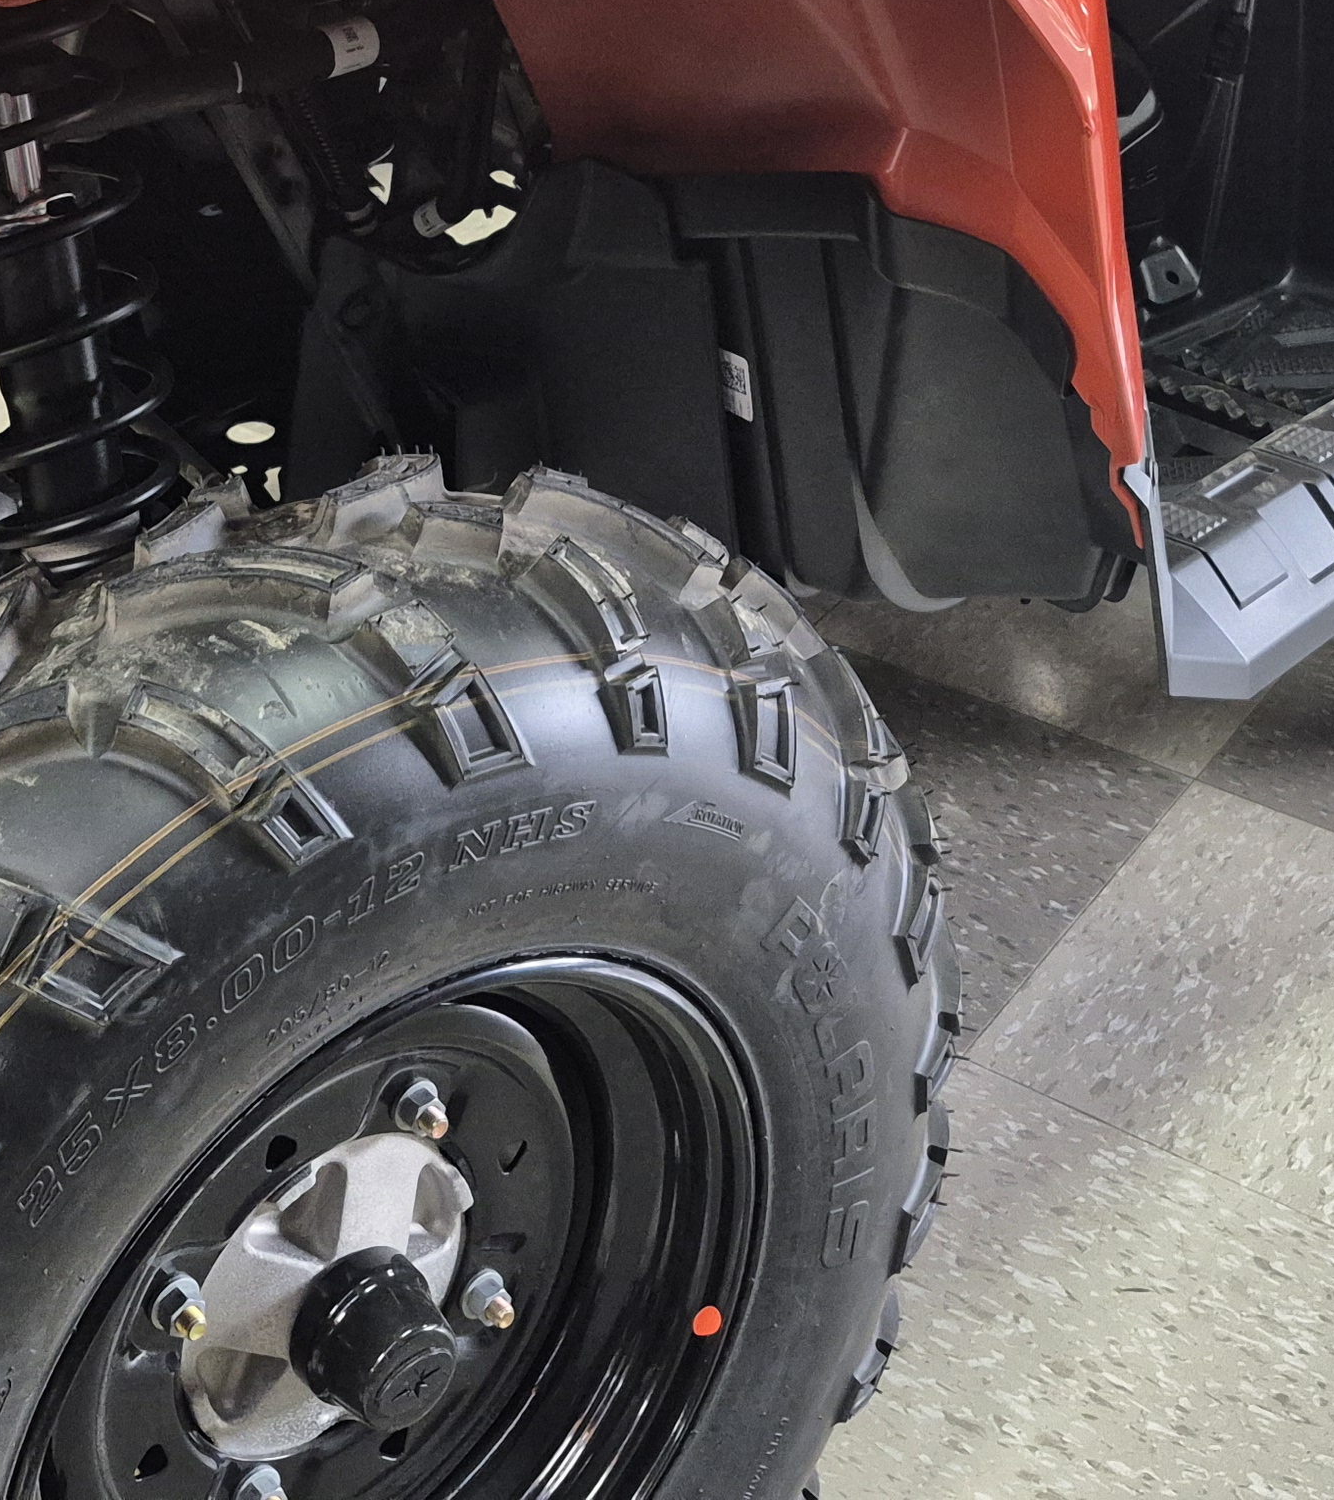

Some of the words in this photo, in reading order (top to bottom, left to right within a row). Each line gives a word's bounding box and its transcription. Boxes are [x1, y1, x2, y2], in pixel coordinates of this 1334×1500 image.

[448, 799, 598, 872] NHS
[693, 807, 746, 835] ROTATION
[503, 888, 534, 907] FOR
[603, 877, 660, 895] SERVICE
[759, 894, 877, 1270] POLARIS
